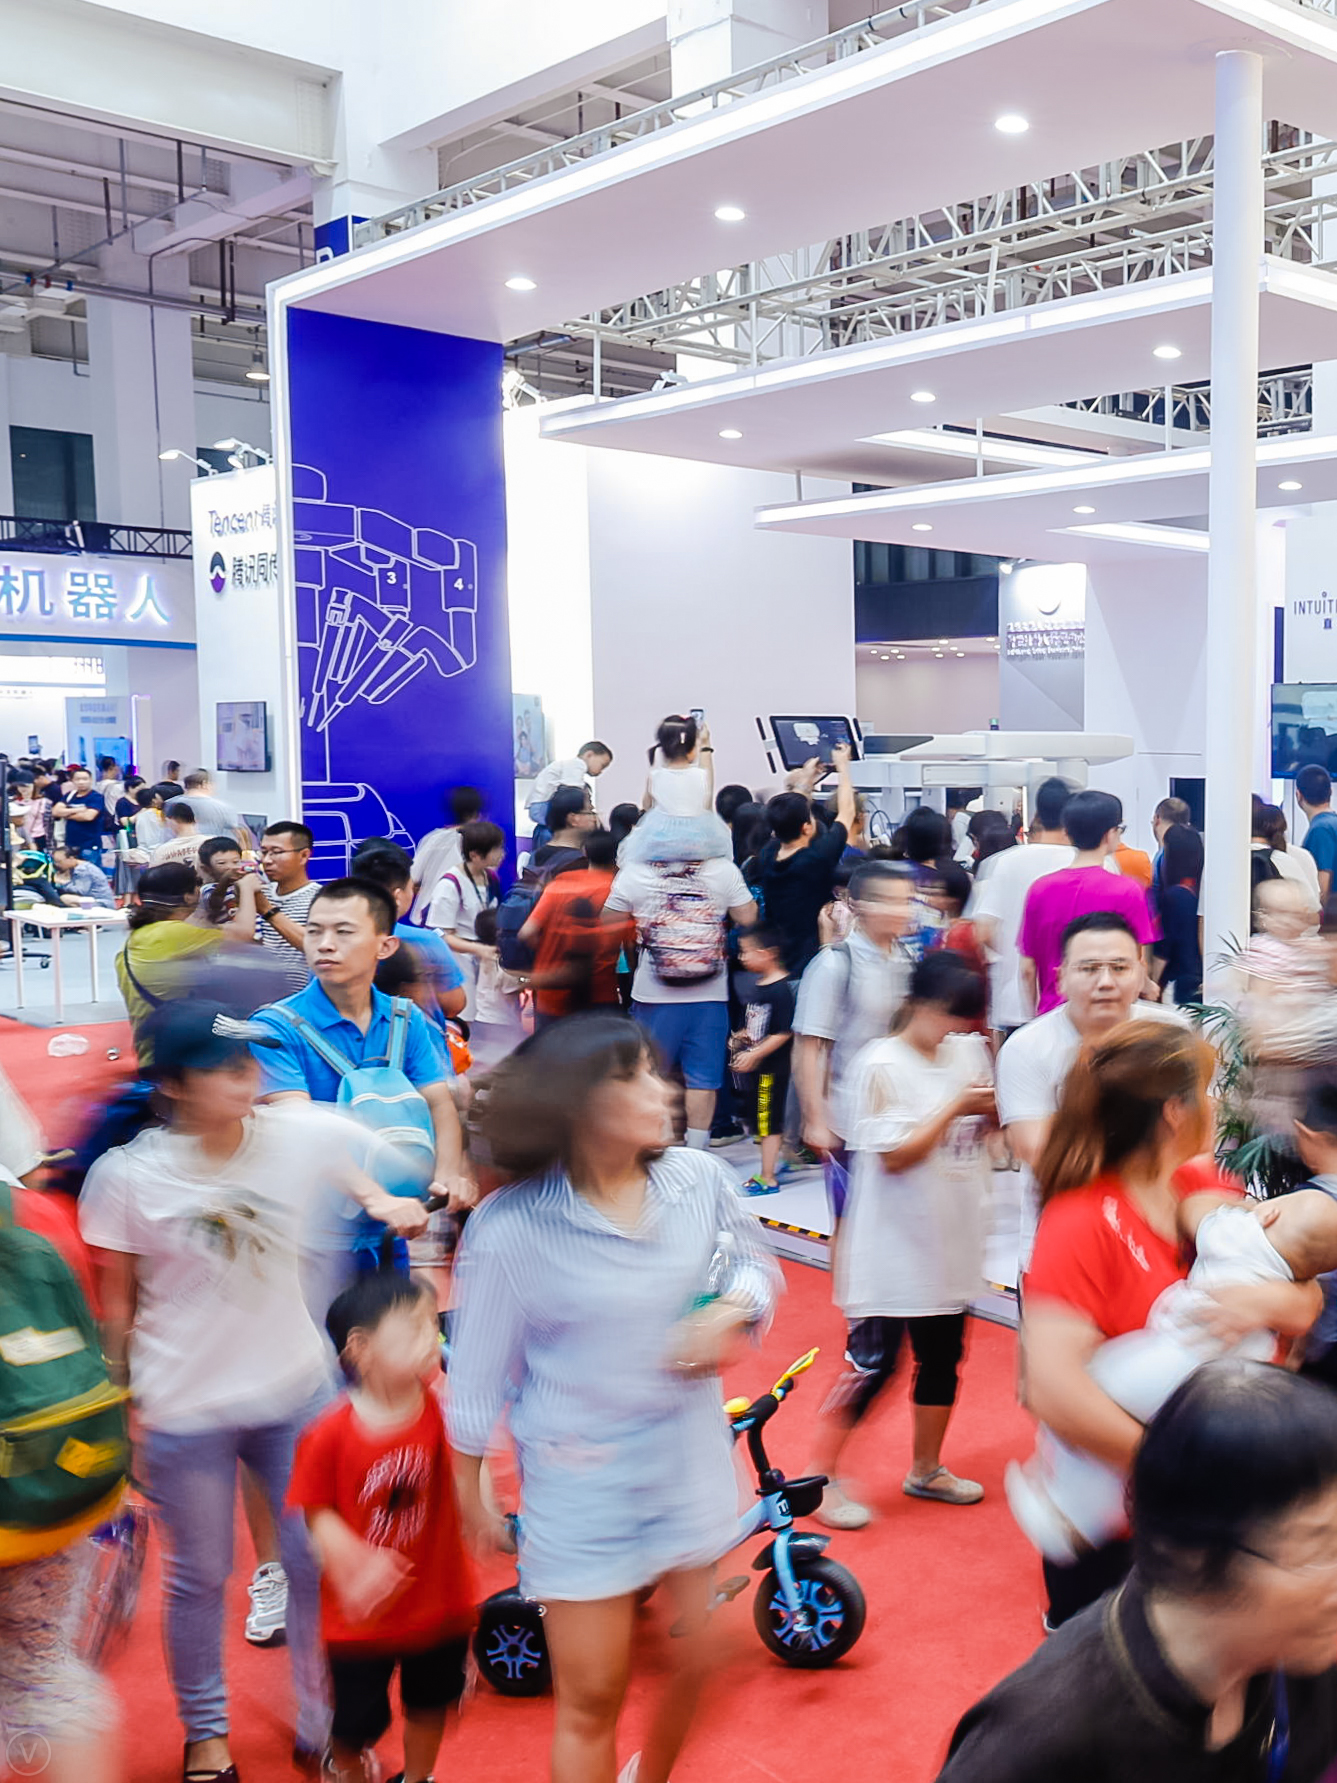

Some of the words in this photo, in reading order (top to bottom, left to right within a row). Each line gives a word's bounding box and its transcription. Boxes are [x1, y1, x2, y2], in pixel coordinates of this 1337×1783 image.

[386, 571, 397, 584] 3
[453, 578, 464, 590] 4
[0, 565, 171, 625] 机器人
